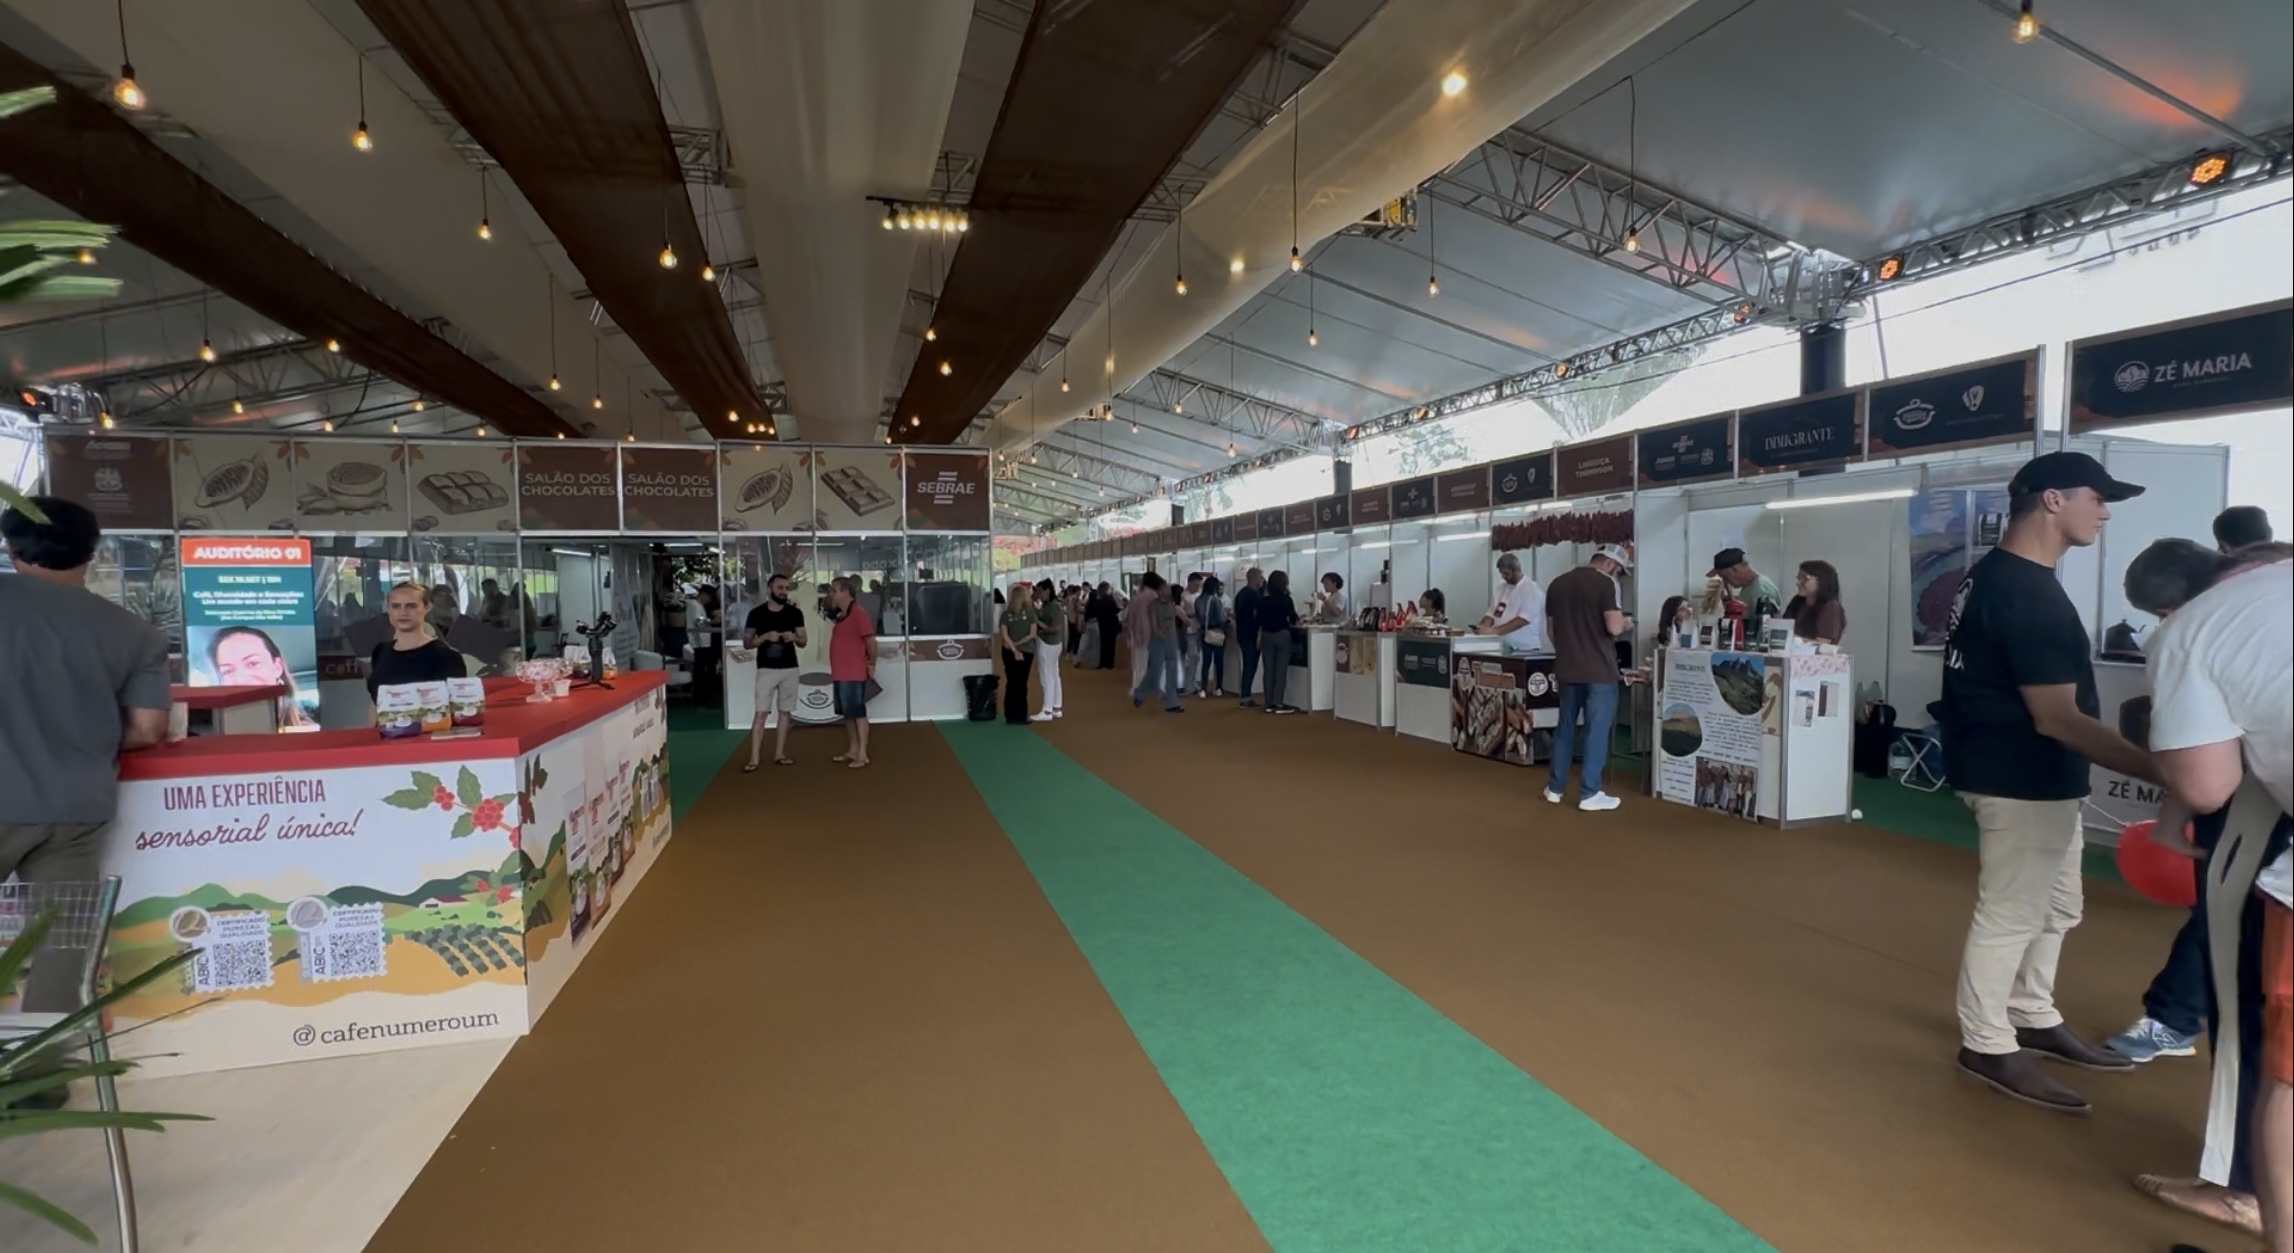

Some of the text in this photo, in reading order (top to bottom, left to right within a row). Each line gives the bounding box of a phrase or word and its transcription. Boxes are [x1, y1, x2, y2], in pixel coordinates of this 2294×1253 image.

[2154, 360, 2178, 383] ZÉ
[2182, 352, 2253, 379] MARIA
[525, 471, 611, 485] SALÃO DOS
[627, 472, 710, 486] SALÃO DOS
[521, 485, 615, 497] CHOCOLATES
[624, 486, 714, 498] CHOCOLATES
[917, 482, 976, 495] SEBRAE
[193, 544, 283, 560] AUDITÓRIO
[164, 776, 327, 810] UMA EXPERIÊNCIA
[2108, 779, 2130, 799] ZÉ
[136, 808, 364, 850] sensorial única!
